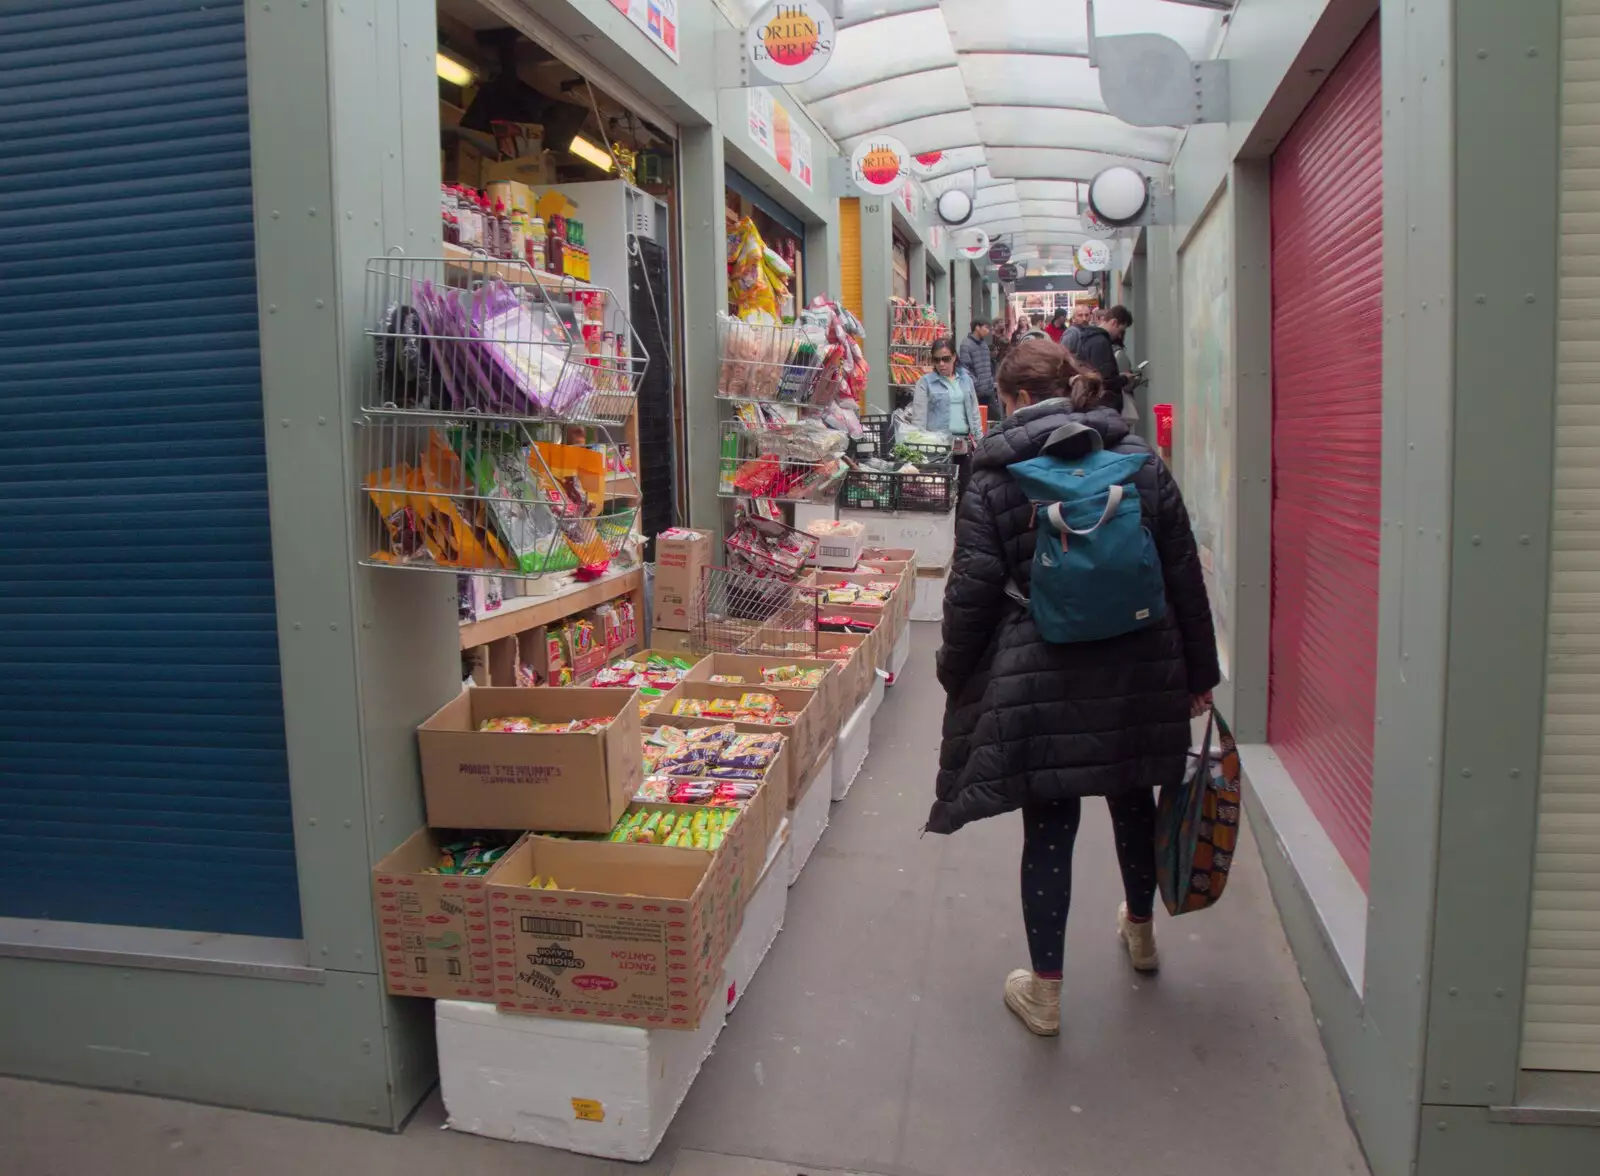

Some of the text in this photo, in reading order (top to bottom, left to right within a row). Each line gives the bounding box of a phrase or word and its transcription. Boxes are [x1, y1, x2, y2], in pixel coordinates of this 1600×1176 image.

[773, 3, 808, 20] THE
[756, 20, 825, 40] ORIENT
[753, 39, 831, 61] EXPRESS
[870, 143, 892, 153] THE
[857, 154, 902, 171] ORIENT
[855, 167, 909, 182] EXPRESS
[864, 204, 880, 214] 163
[526, 953, 586, 969] ORIGINAL
[610, 950, 656, 961] CANTON
[618, 961, 657, 972] PANCIT
[518, 970, 562, 999] SINGLES
